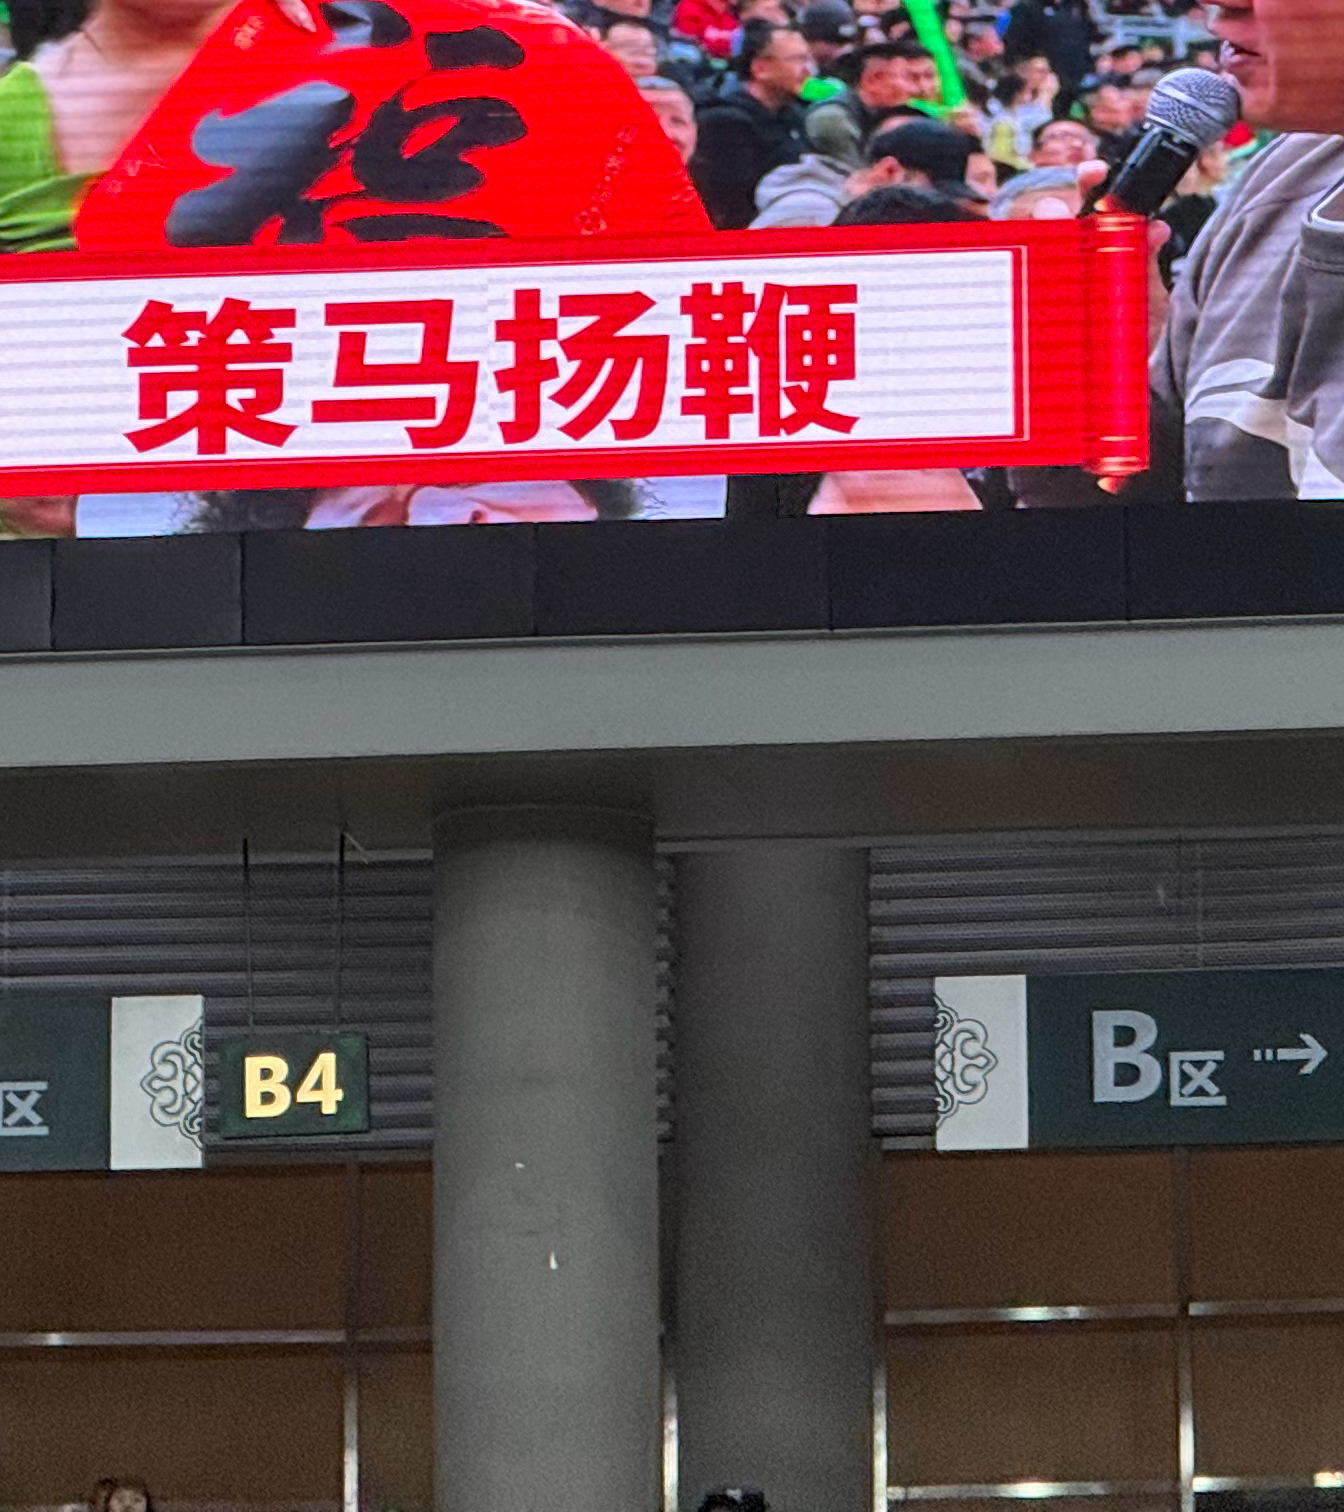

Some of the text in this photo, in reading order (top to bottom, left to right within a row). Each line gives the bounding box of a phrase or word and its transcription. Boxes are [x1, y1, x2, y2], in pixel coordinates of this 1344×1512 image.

[121, 282, 860, 456] 策马扬鞭
[243, 1052, 345, 1119] B4
[1091, 1008, 1227, 1108] B区
